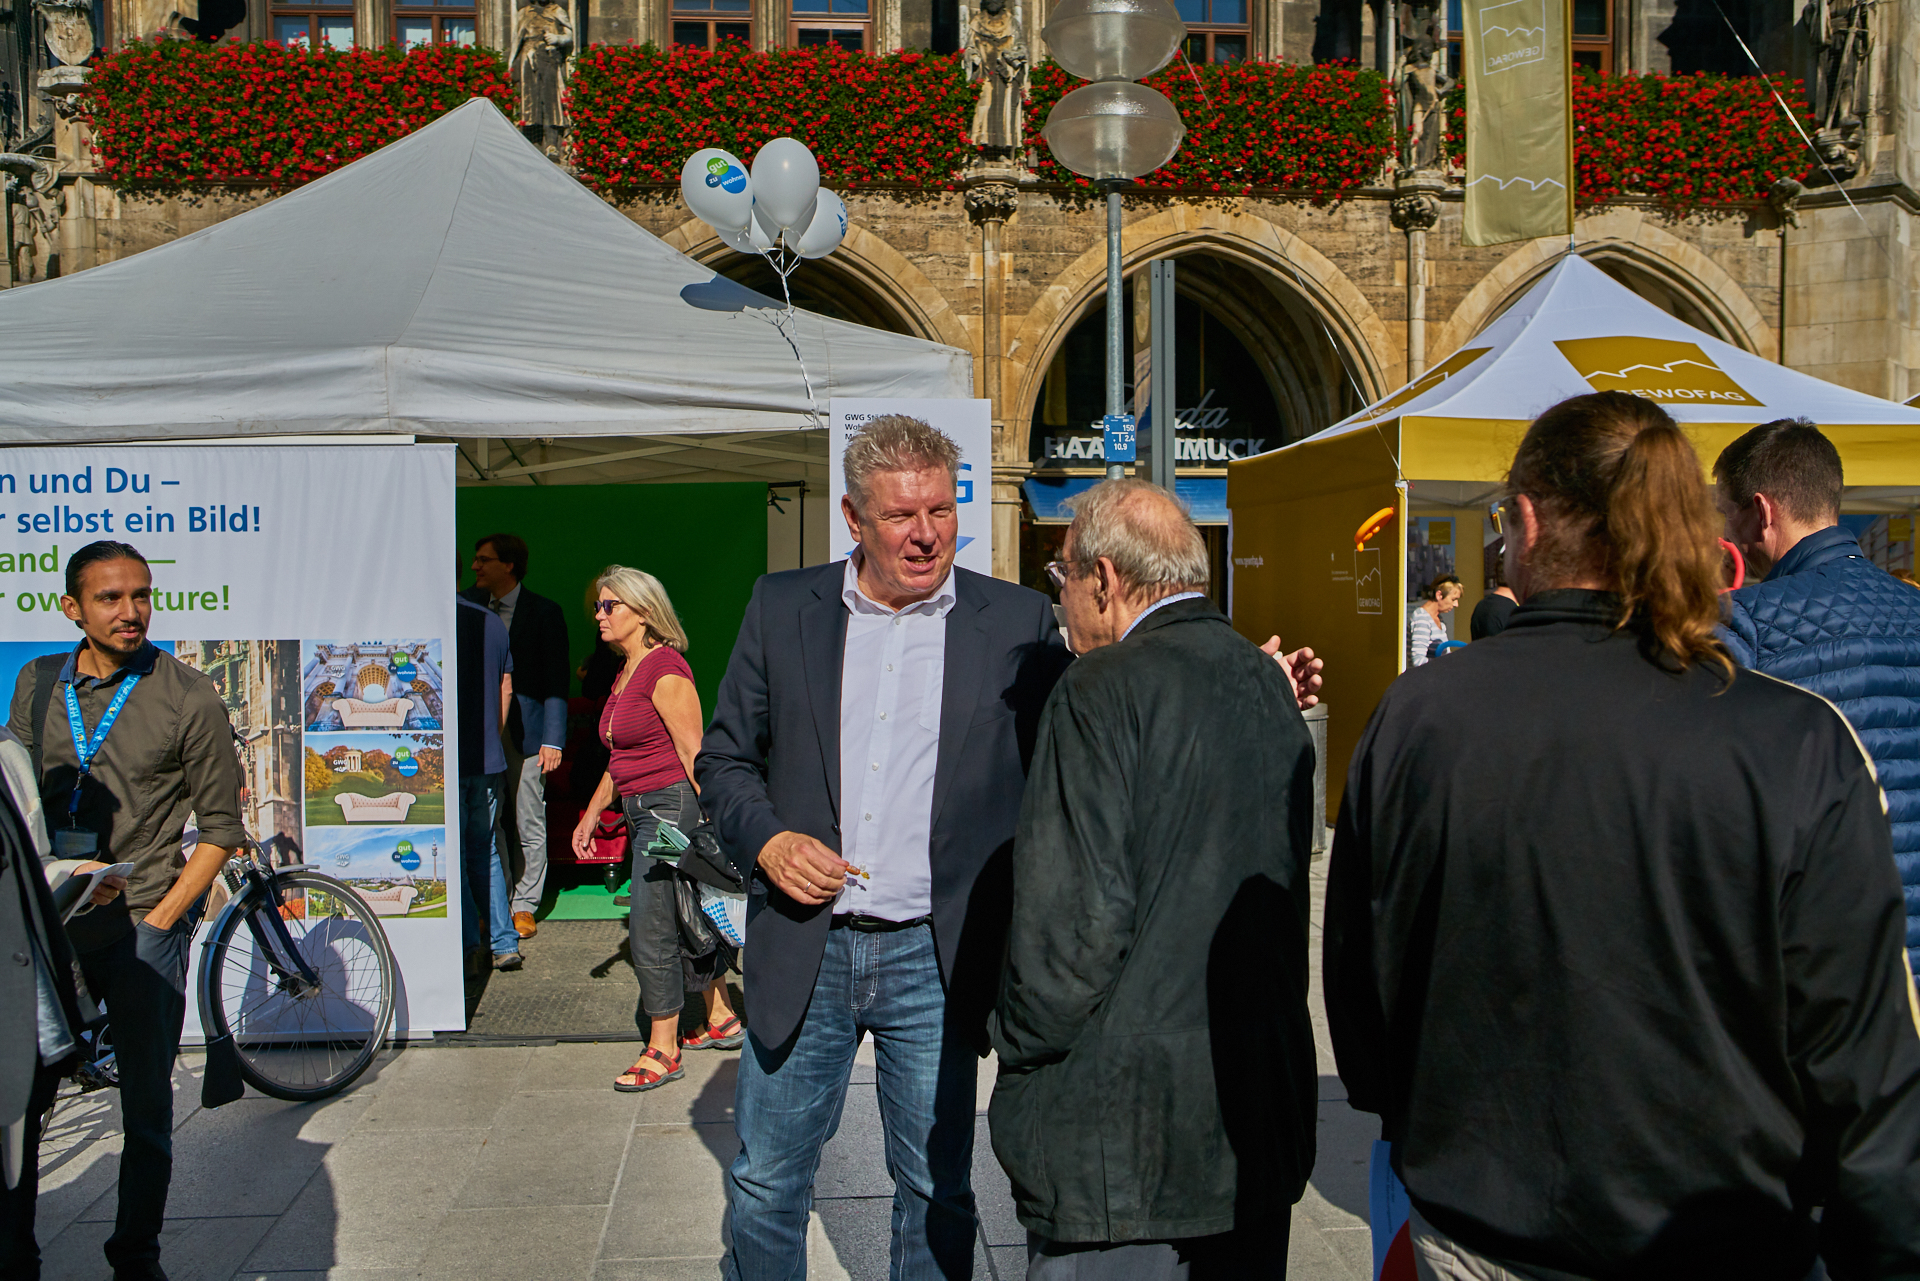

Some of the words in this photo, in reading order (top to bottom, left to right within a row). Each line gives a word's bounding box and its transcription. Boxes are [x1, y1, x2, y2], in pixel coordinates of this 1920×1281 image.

[708, 159, 727, 174] gut
[708, 176, 718, 184] zu
[722, 174, 745, 187] wohnen
[844, 413, 865, 421] GWG
[1105, 424, 1110, 432] S
[1122, 424, 1135, 432] 150
[29, 466, 93, 494] und
[105, 467, 151, 494] Du
[17, 505, 114, 533] selbst
[124, 506, 175, 533] ein
[188, 505, 261, 533] Bild!
[0, 545, 59, 573] and
[17, 591, 63, 612] ow
[1358, 597, 1381, 608] GEWOFAG
[394, 656, 408, 665] gut
[396, 751, 409, 759] gut
[398, 844, 411, 853] gut
